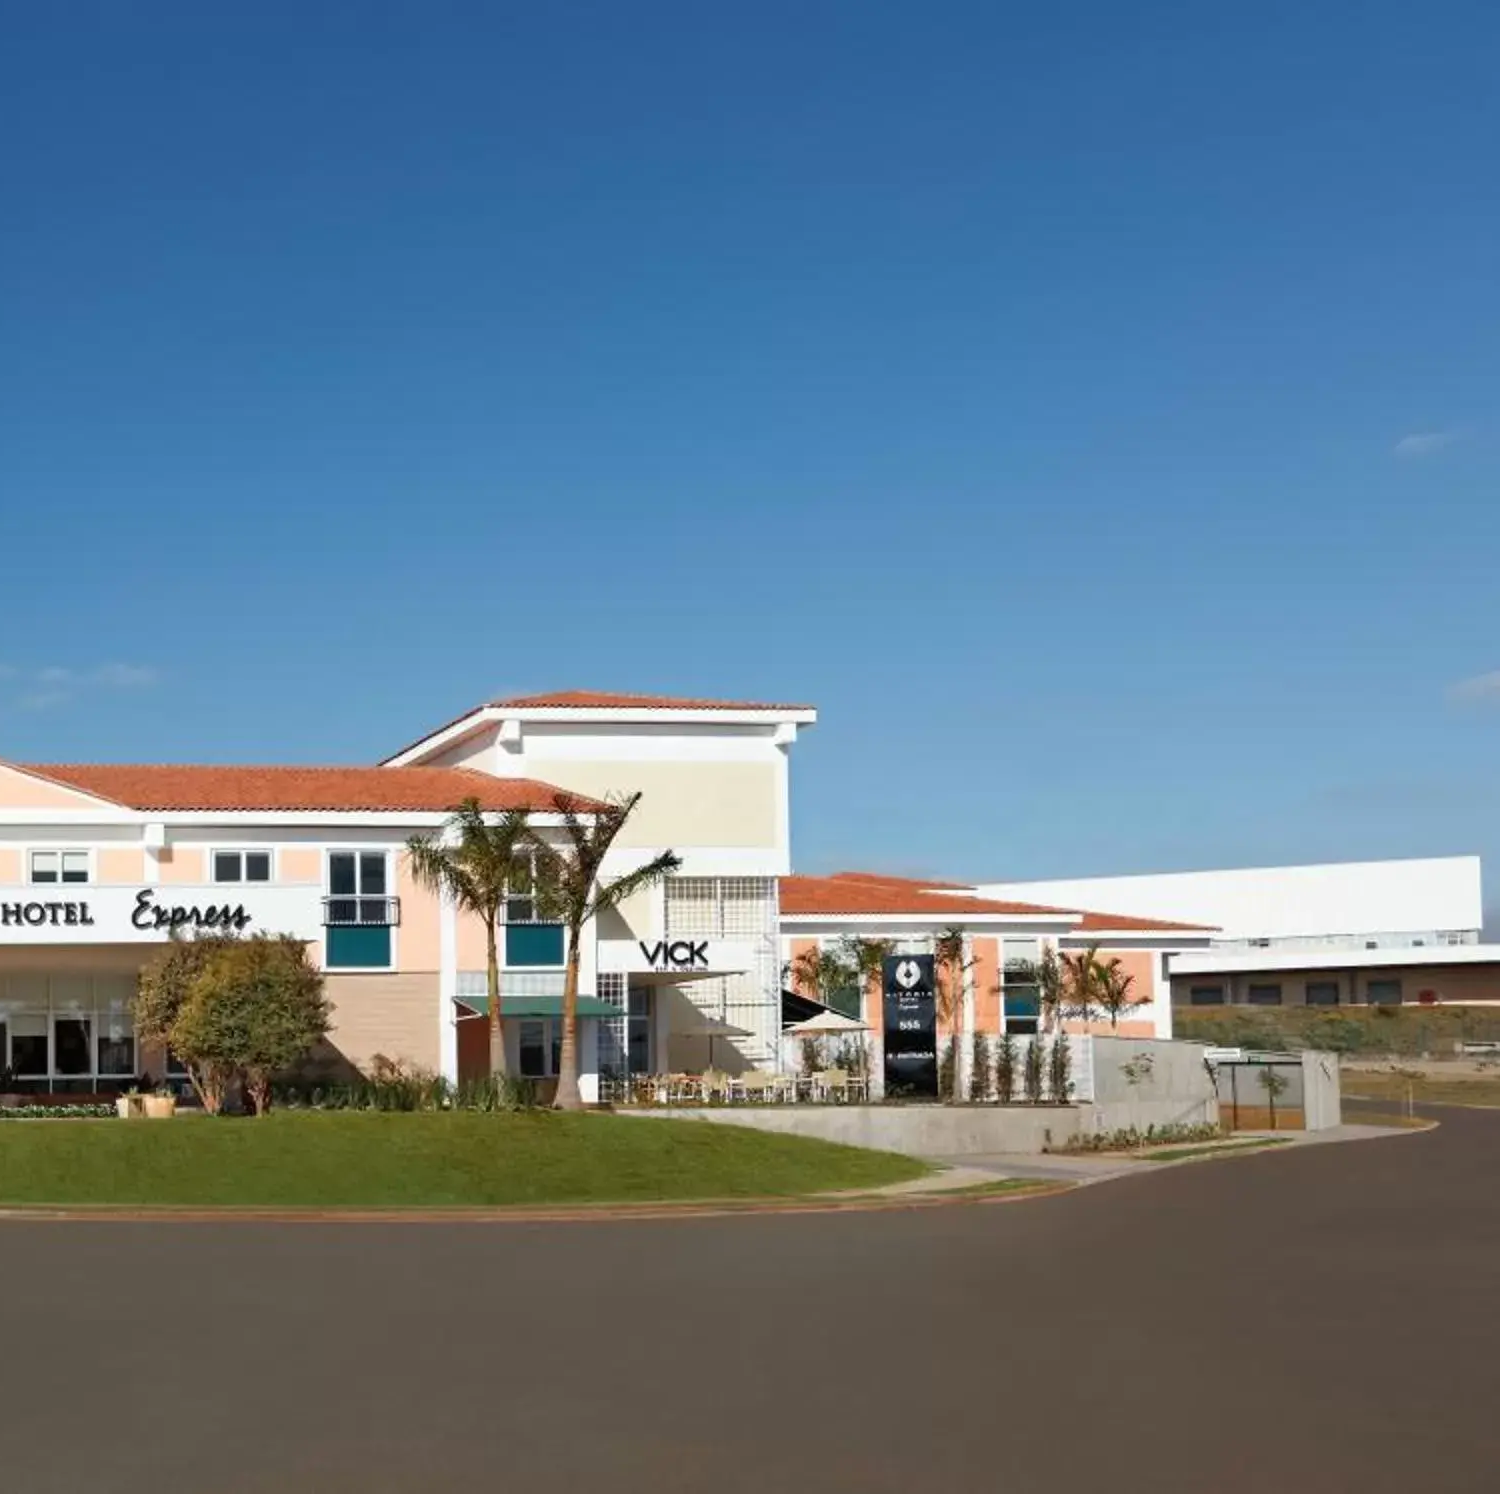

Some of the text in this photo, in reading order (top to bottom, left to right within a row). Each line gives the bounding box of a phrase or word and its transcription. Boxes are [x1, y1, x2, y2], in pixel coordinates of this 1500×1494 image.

[1, 902, 94, 926] HOTEL
[131, 888, 252, 937] Express
[639, 941, 708, 966] VICK
